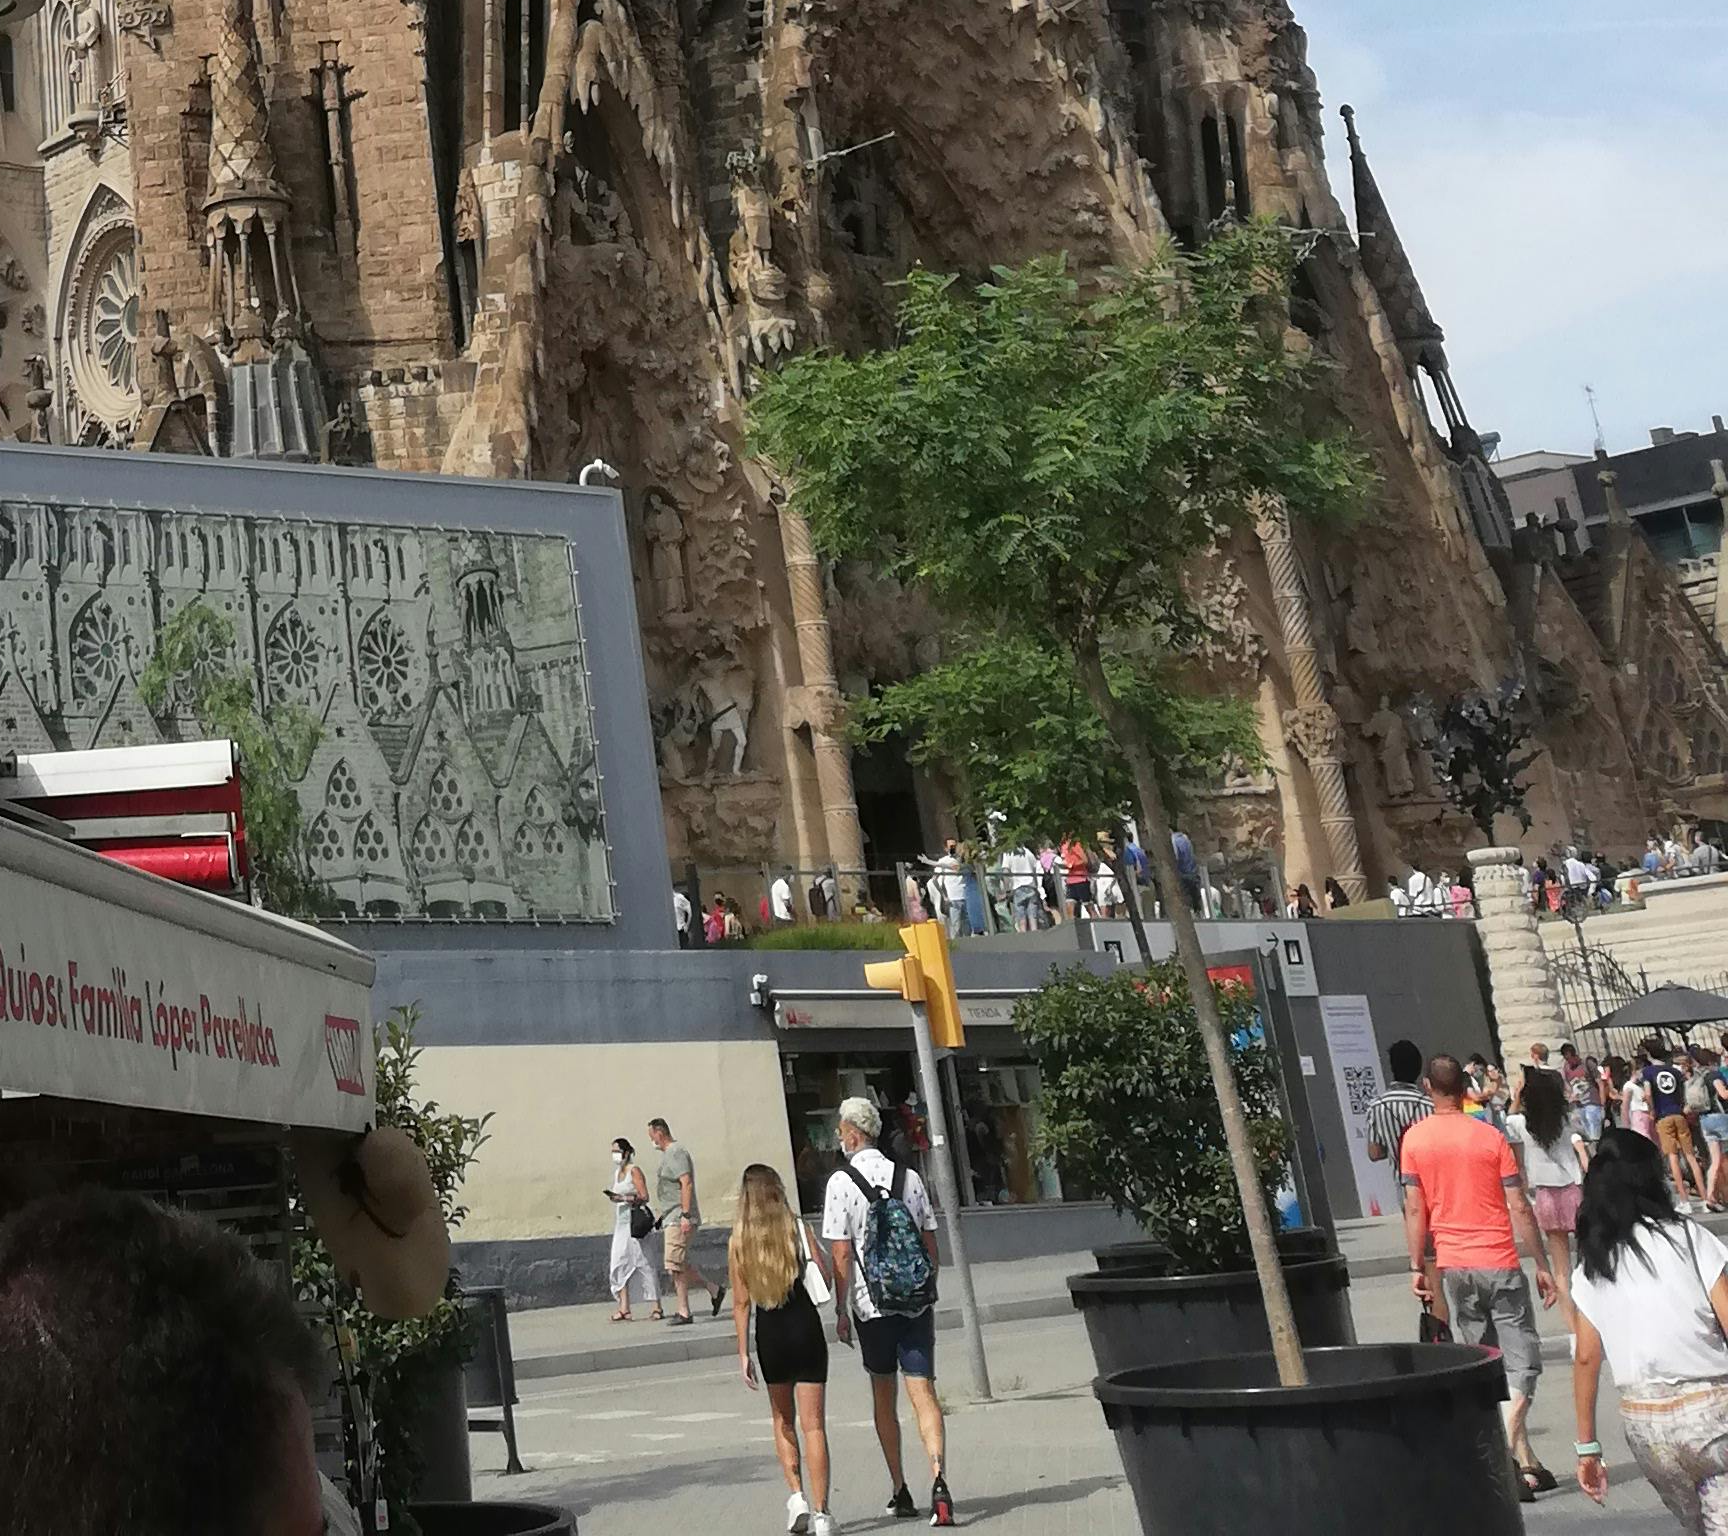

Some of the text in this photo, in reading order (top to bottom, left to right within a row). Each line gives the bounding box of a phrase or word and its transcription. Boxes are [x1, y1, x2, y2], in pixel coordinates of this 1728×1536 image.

[68, 959, 144, 1044] Familia
[145, 979, 200, 1071] López
[200, 993, 281, 1068] Parellada
